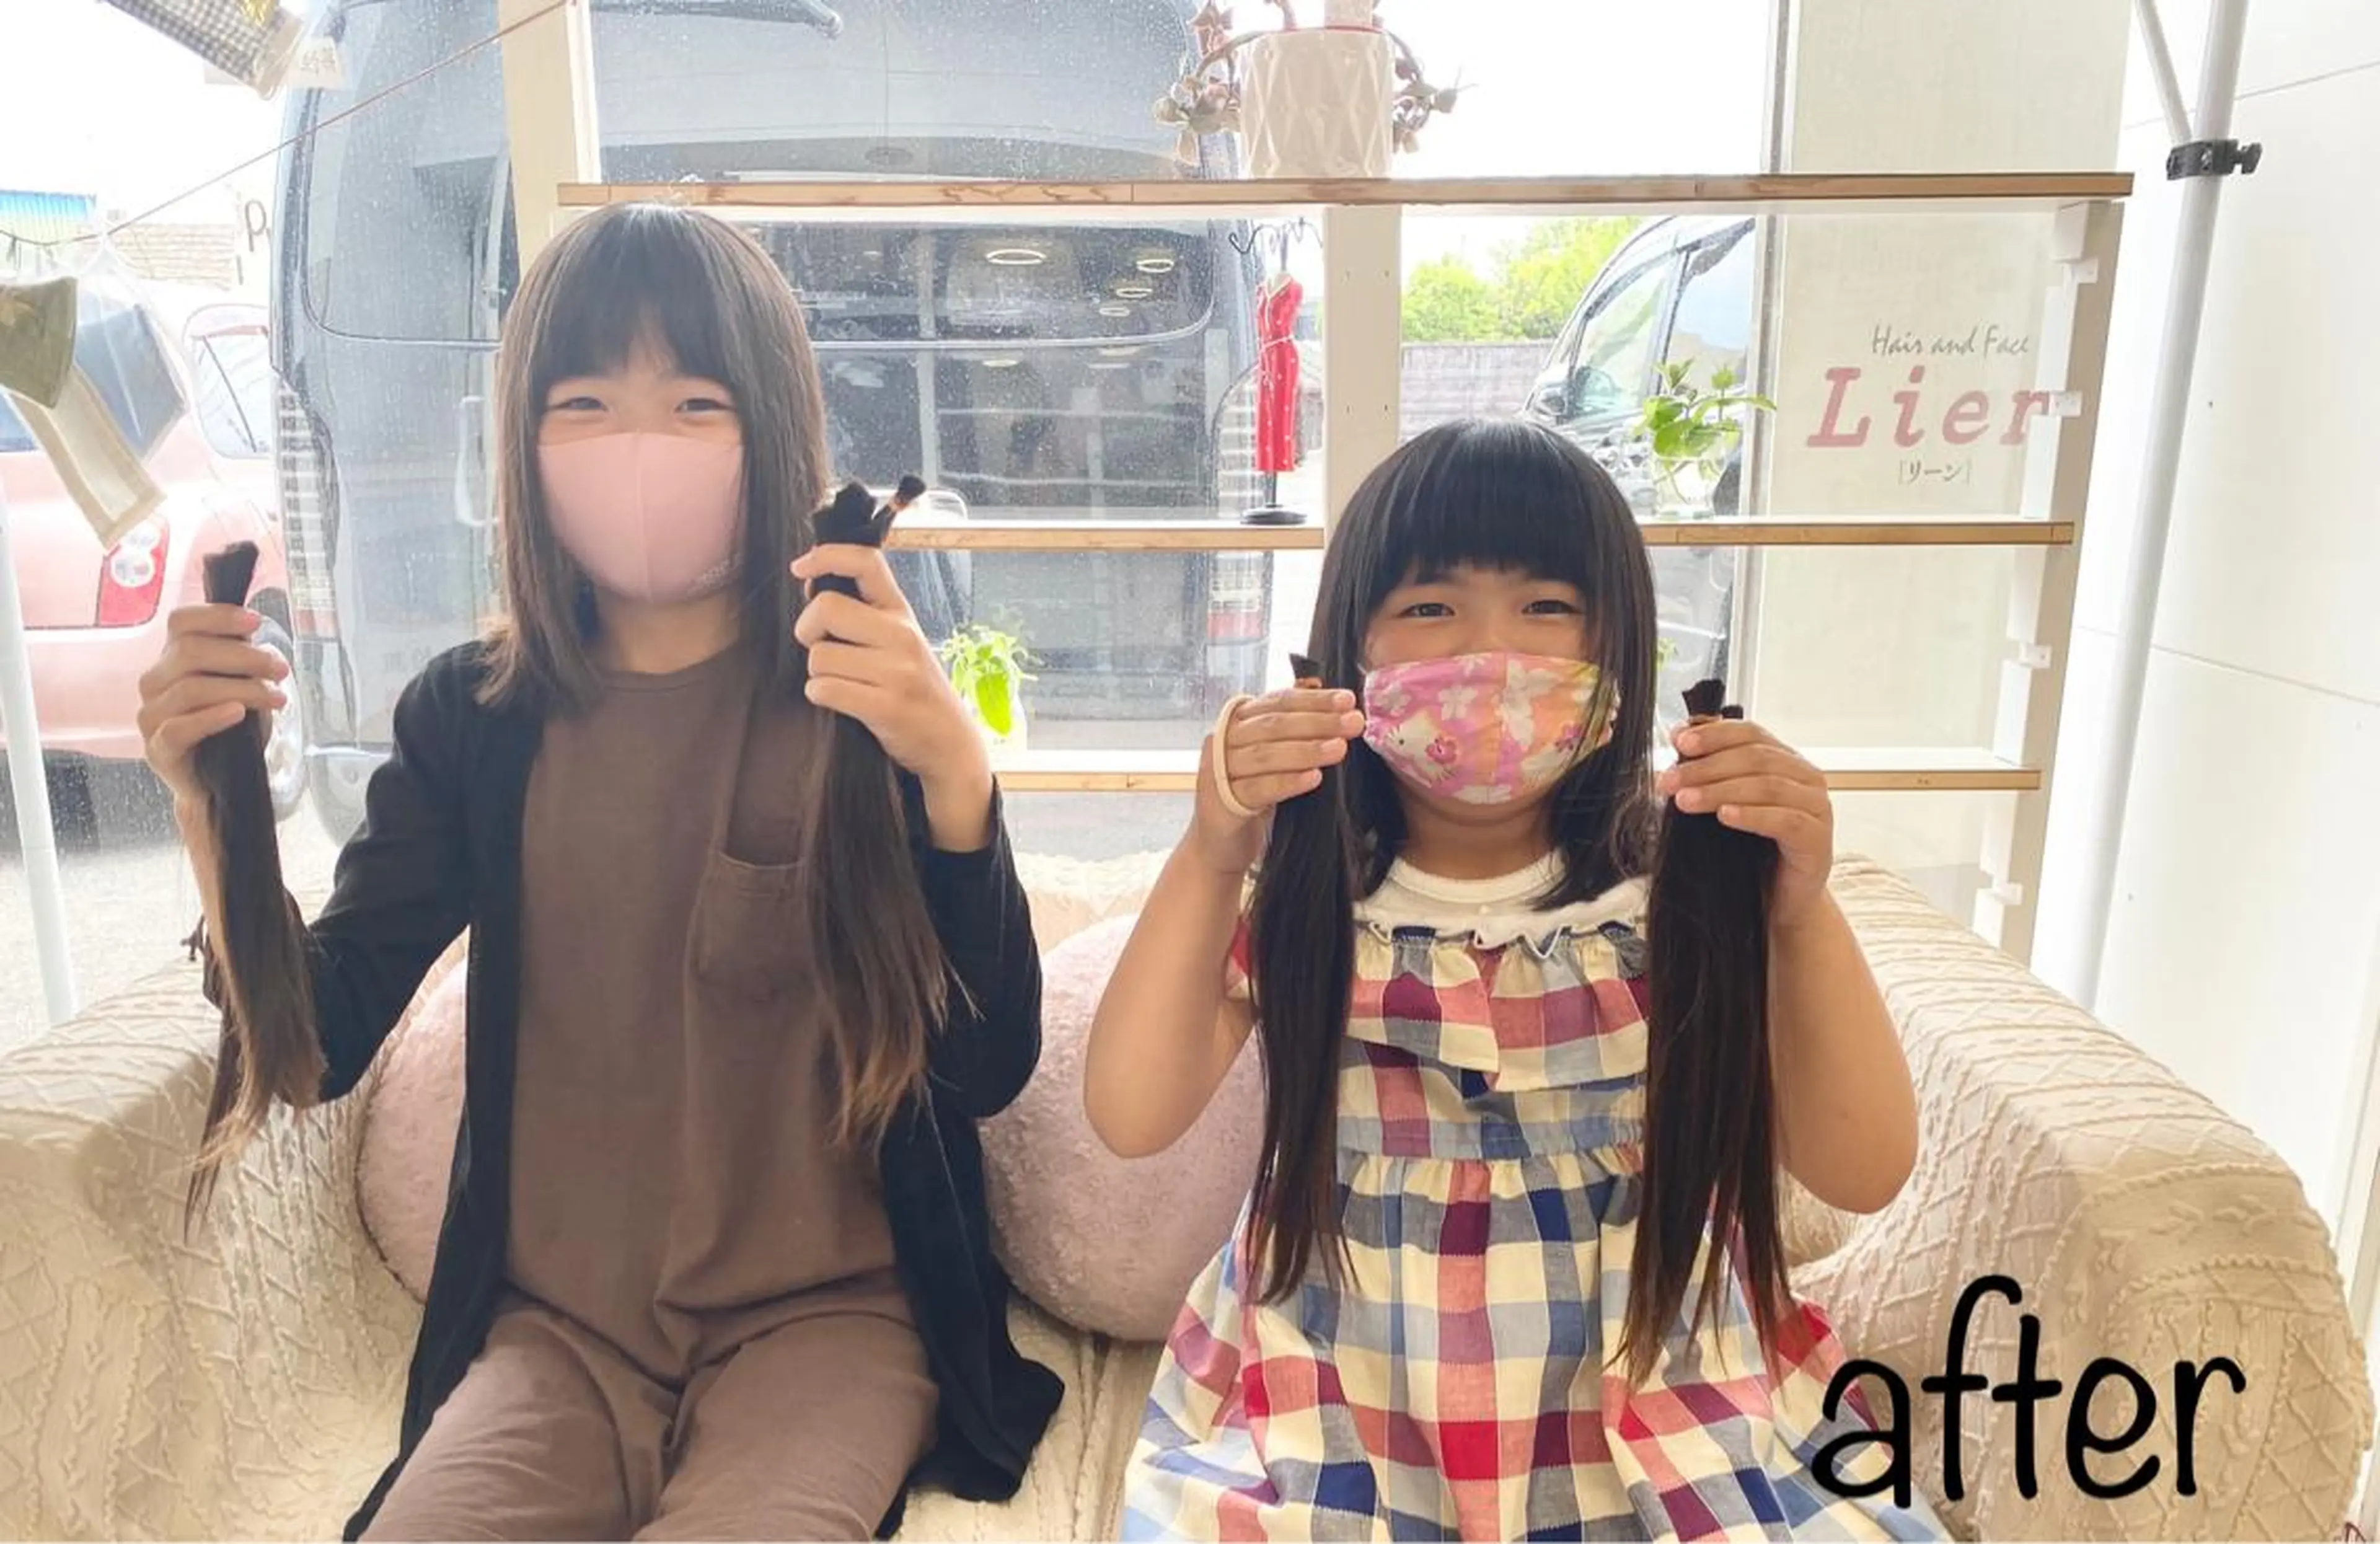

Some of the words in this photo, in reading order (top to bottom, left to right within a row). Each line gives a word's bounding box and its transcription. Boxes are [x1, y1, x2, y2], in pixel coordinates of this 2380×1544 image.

[1872, 325, 1923, 356] Hair
[1931, 325, 1979, 355] and
[1983, 324, 2029, 359] Face
